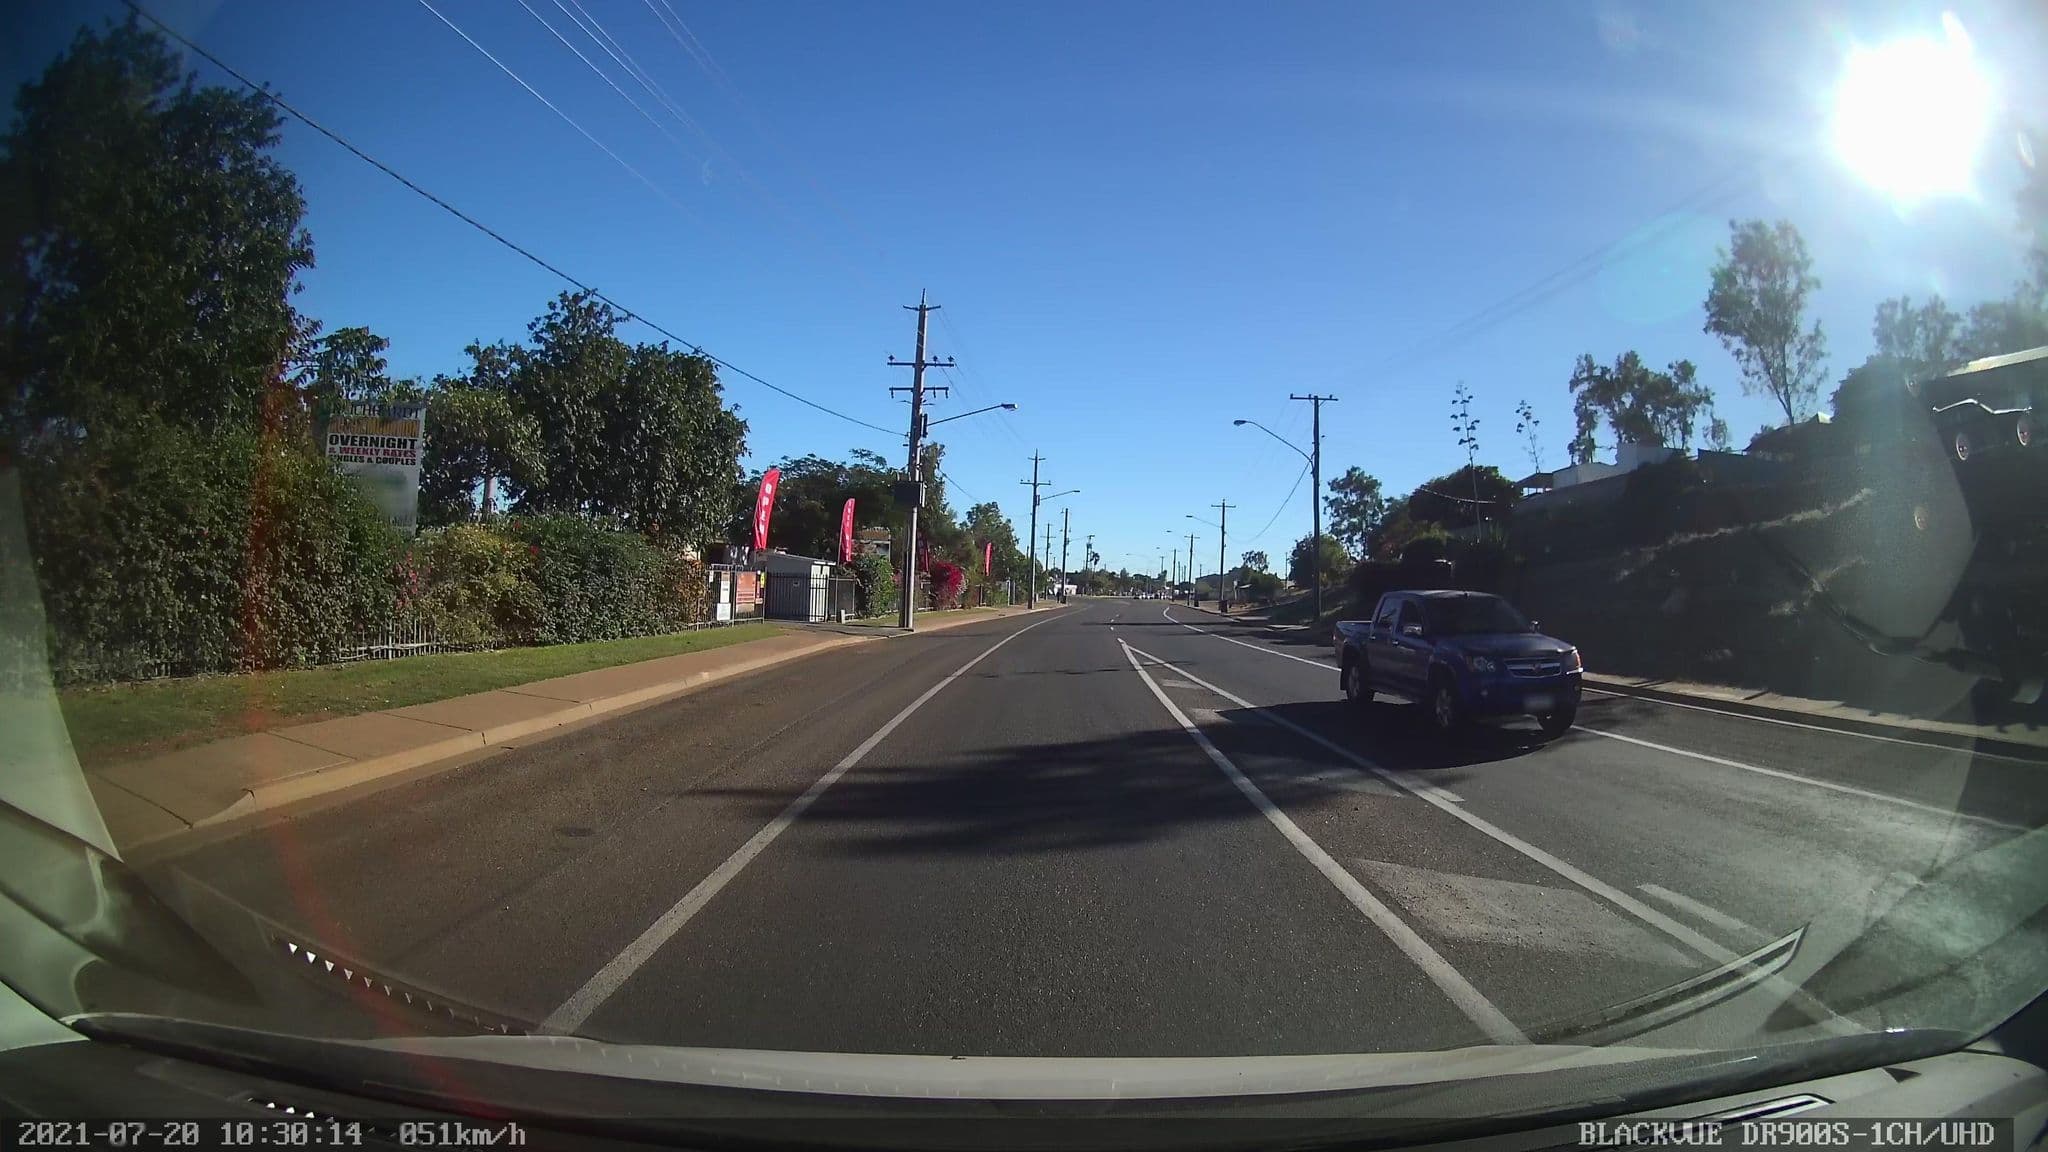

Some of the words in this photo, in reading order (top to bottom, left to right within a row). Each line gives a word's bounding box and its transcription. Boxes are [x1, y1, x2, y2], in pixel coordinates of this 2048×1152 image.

[329, 435, 418, 449] OVERNIGHT
[339, 447, 382, 456] WEEKLY
[383, 449, 417, 458] RATES
[376, 457, 416, 466] COUPLES
